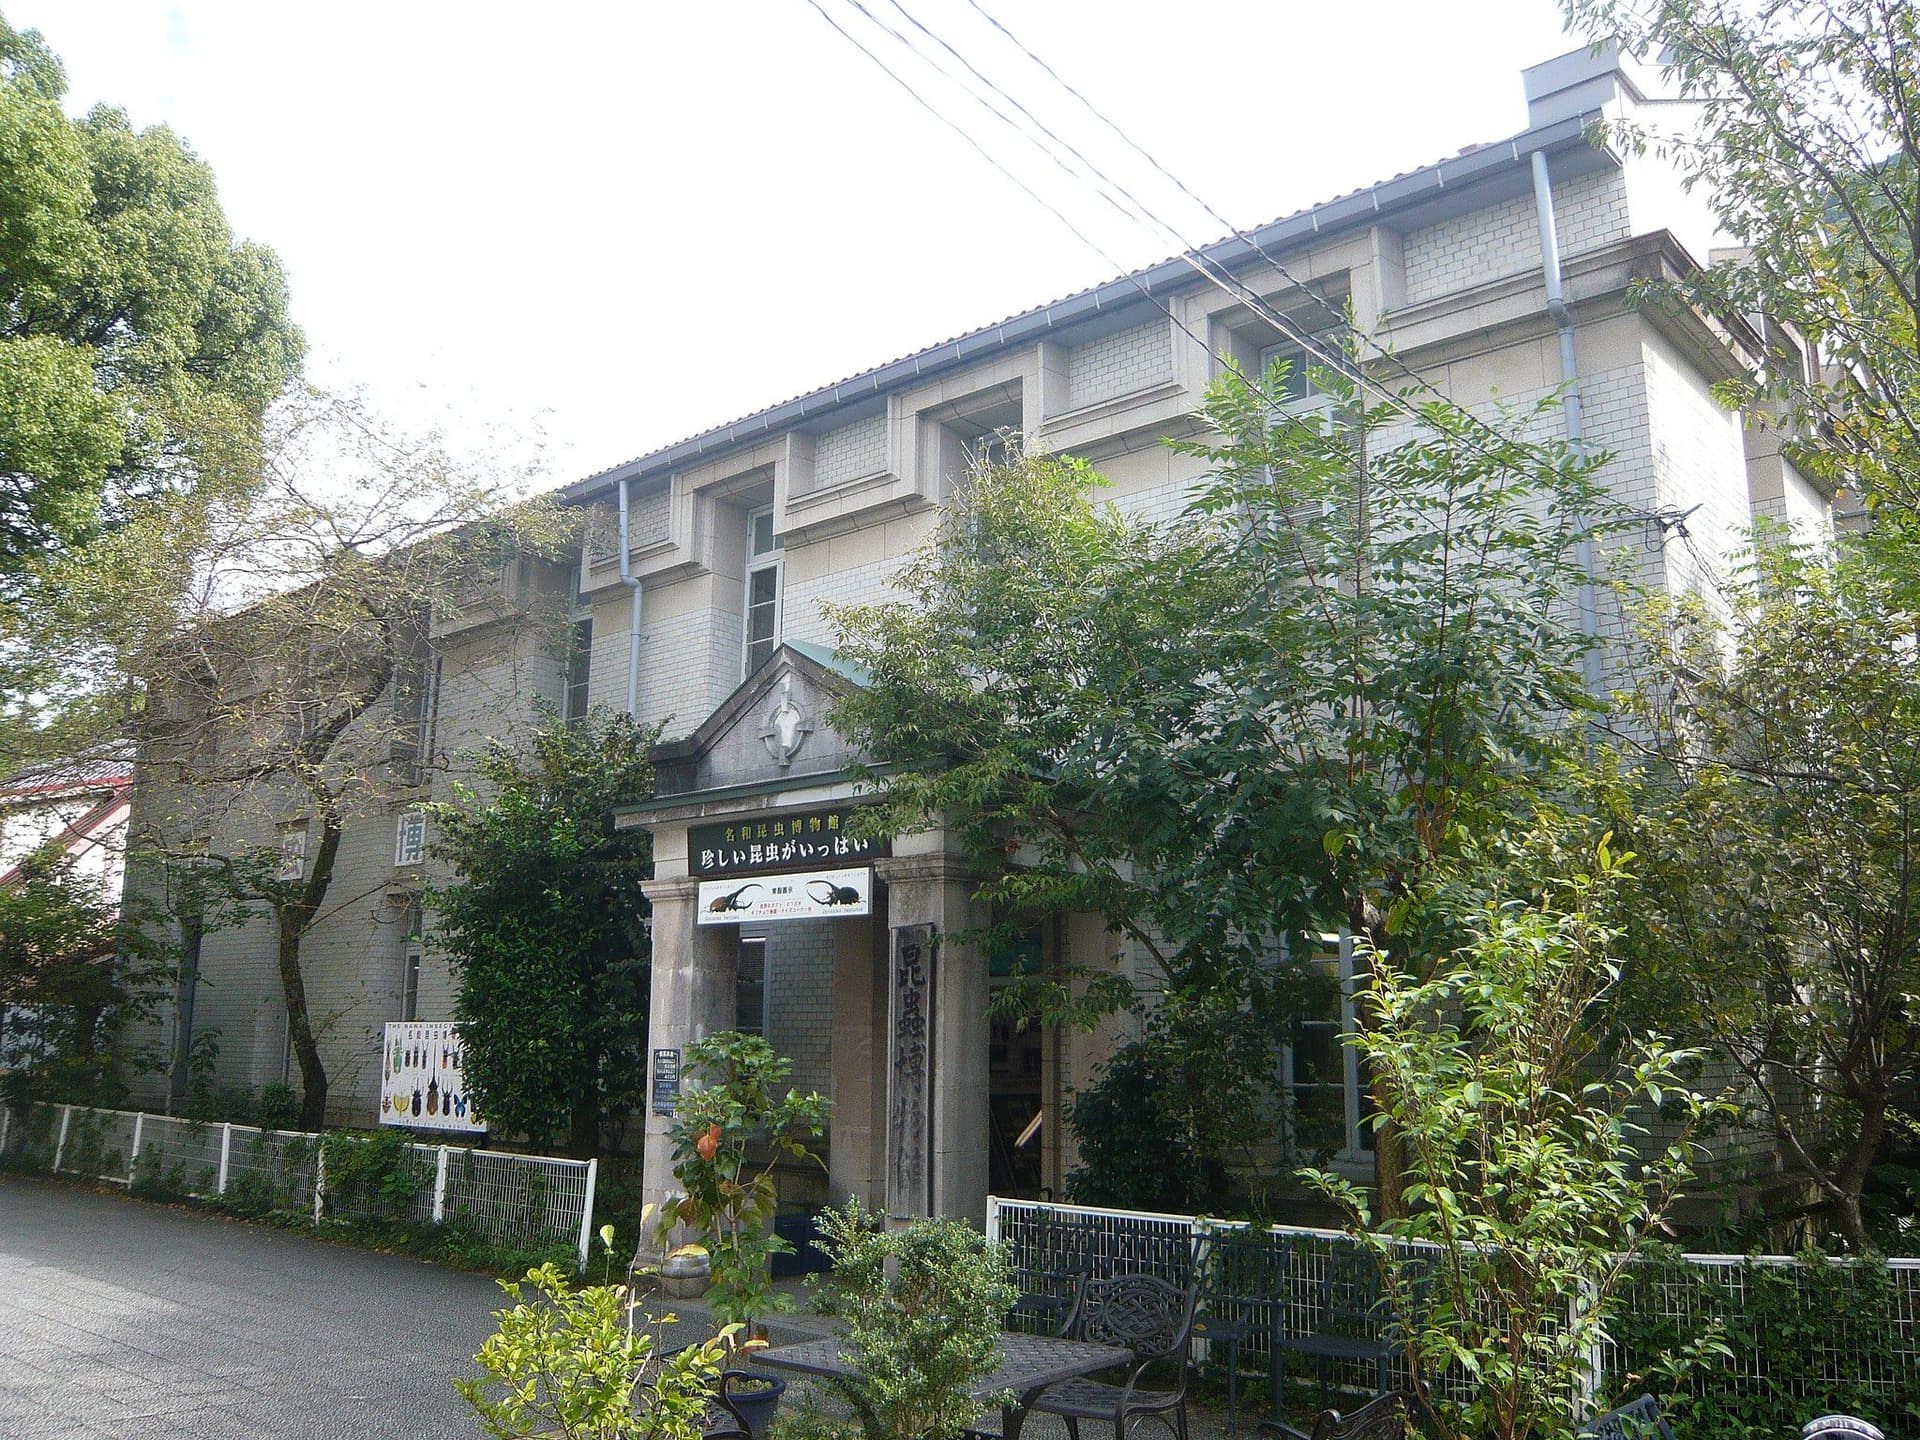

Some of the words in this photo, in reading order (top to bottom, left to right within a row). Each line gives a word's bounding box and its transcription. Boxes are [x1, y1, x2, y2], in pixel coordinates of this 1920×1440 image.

[726, 814, 839, 842] 名和昆虫博物館
